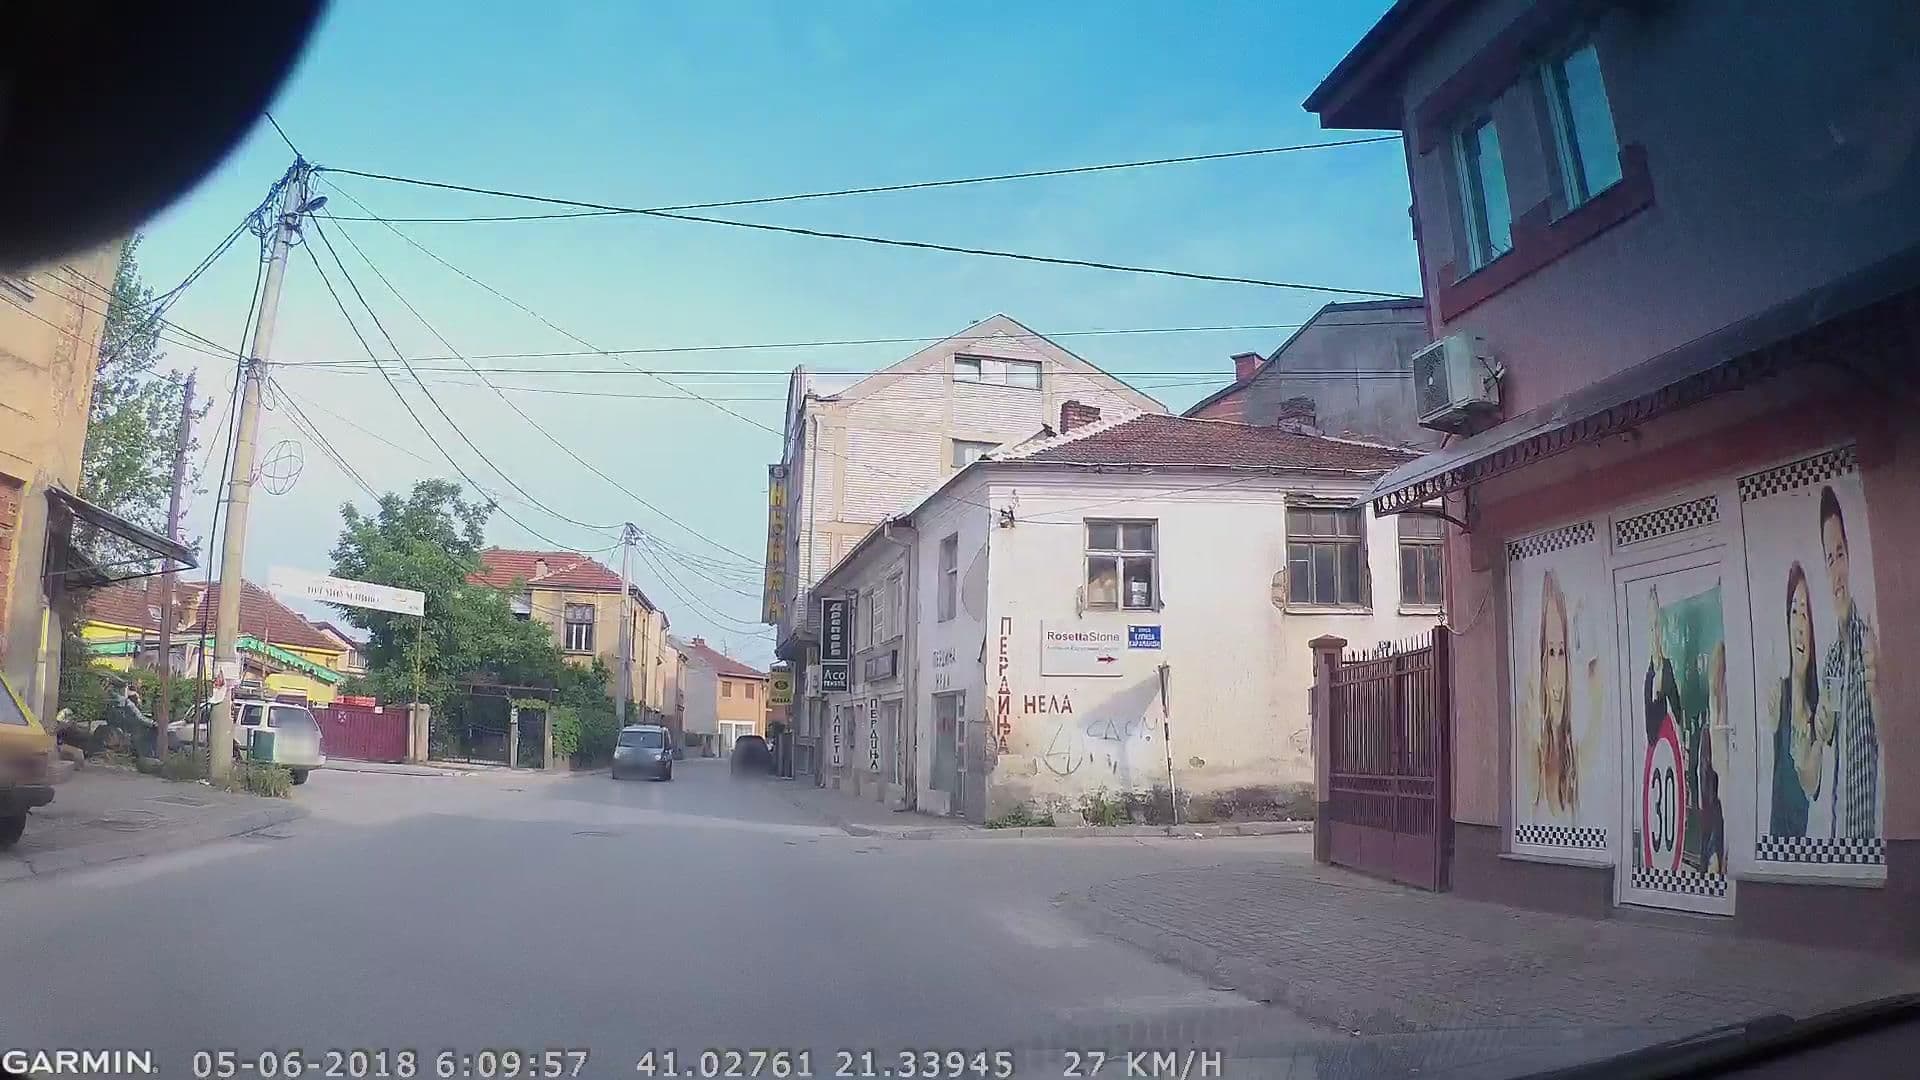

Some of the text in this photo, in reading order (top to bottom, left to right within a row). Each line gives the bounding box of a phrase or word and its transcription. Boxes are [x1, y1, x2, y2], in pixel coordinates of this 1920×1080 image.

[1047, 631, 1120, 642] RosettaStone
[1024, 694, 1073, 714] НЕЛА
[1651, 767, 1675, 853] 30
